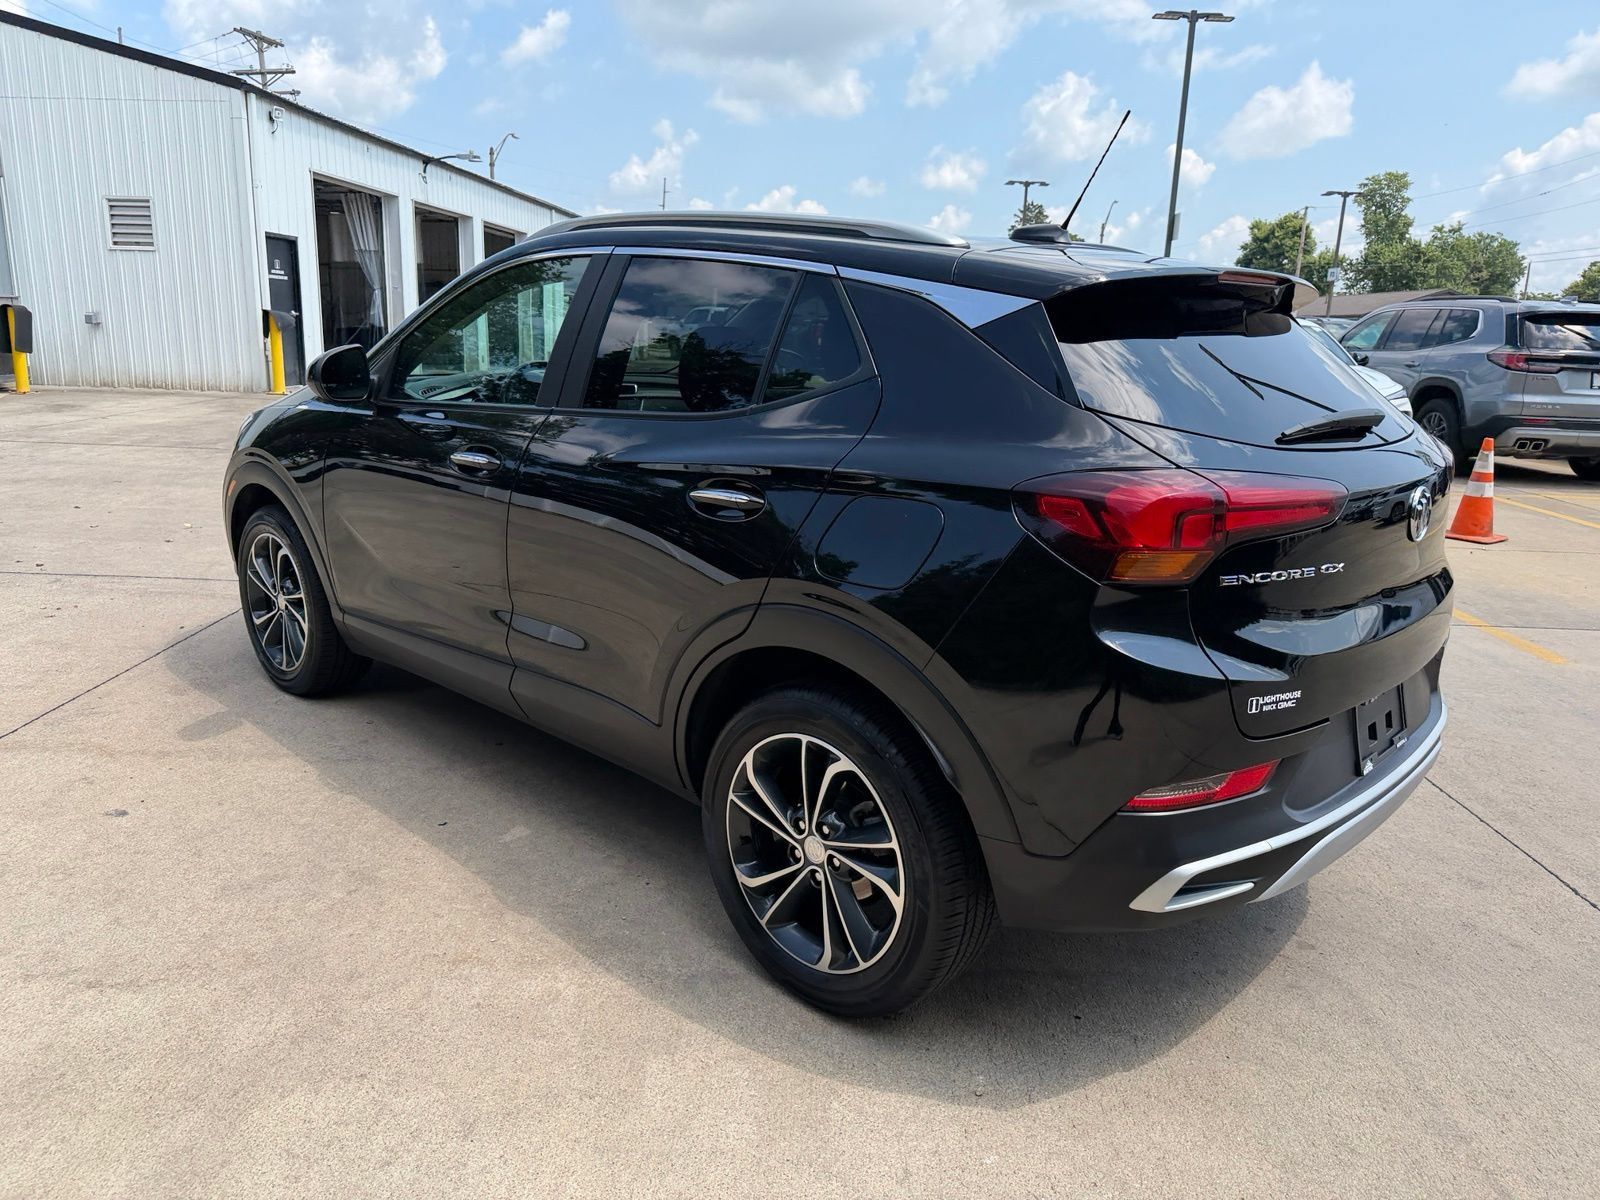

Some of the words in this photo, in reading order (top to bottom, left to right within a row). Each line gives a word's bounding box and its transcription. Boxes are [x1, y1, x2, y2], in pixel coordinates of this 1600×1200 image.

[1219, 567, 1315, 586] ENCORE
[1320, 562, 1345, 574] GX
[1260, 690, 1302, 704] LIGHTHOUSE
[1277, 699, 1297, 709] GMC
